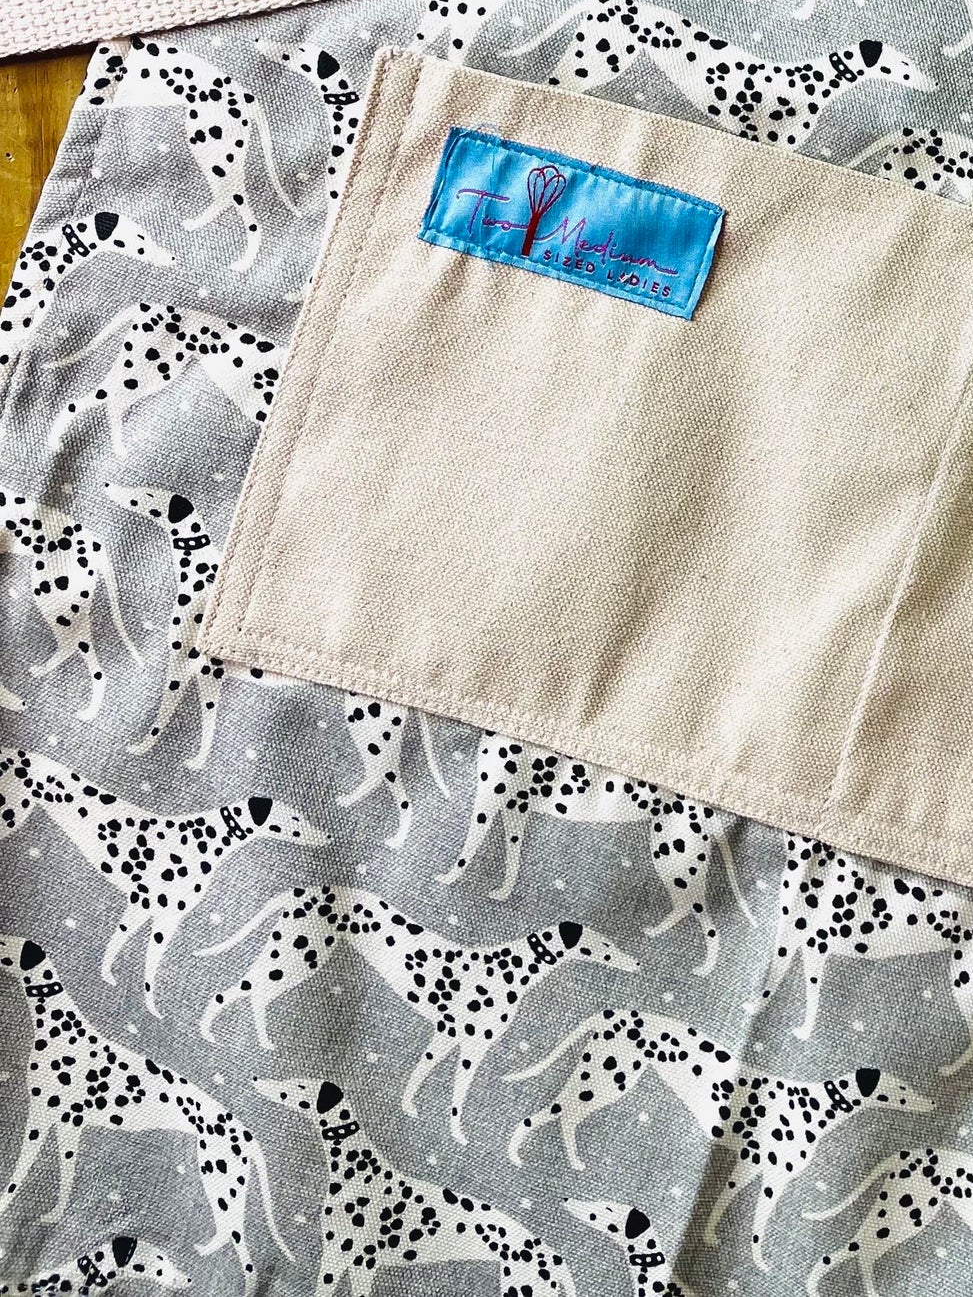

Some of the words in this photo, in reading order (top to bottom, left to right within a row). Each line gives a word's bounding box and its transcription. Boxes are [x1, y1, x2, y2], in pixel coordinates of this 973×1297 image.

[456, 188, 528, 235] Two
[534, 216, 679, 275] Medium
[543, 249, 596, 274] SIZED
